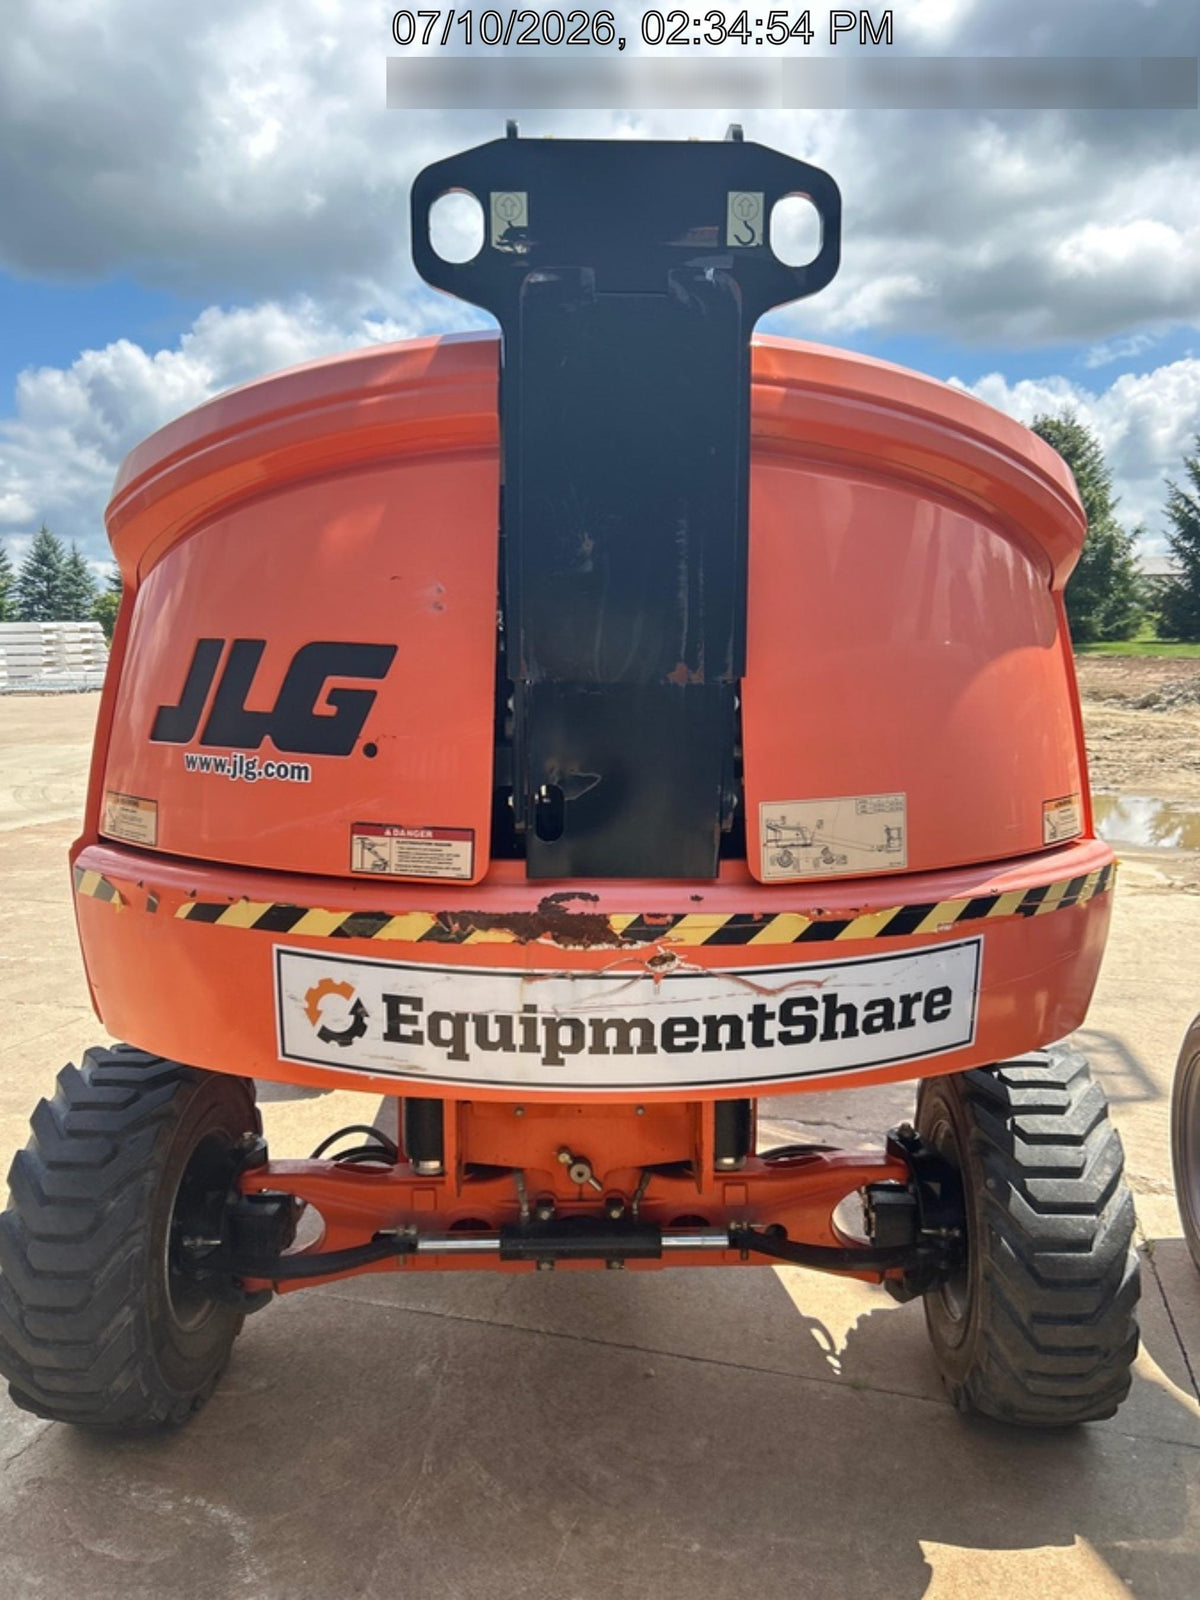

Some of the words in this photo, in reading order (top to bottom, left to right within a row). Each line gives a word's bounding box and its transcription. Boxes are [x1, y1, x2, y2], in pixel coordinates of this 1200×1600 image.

[185, 753, 310, 782] www.jlg.com
[393, 829, 433, 838] DANGER
[383, 985, 953, 1066] EquipmentShare
